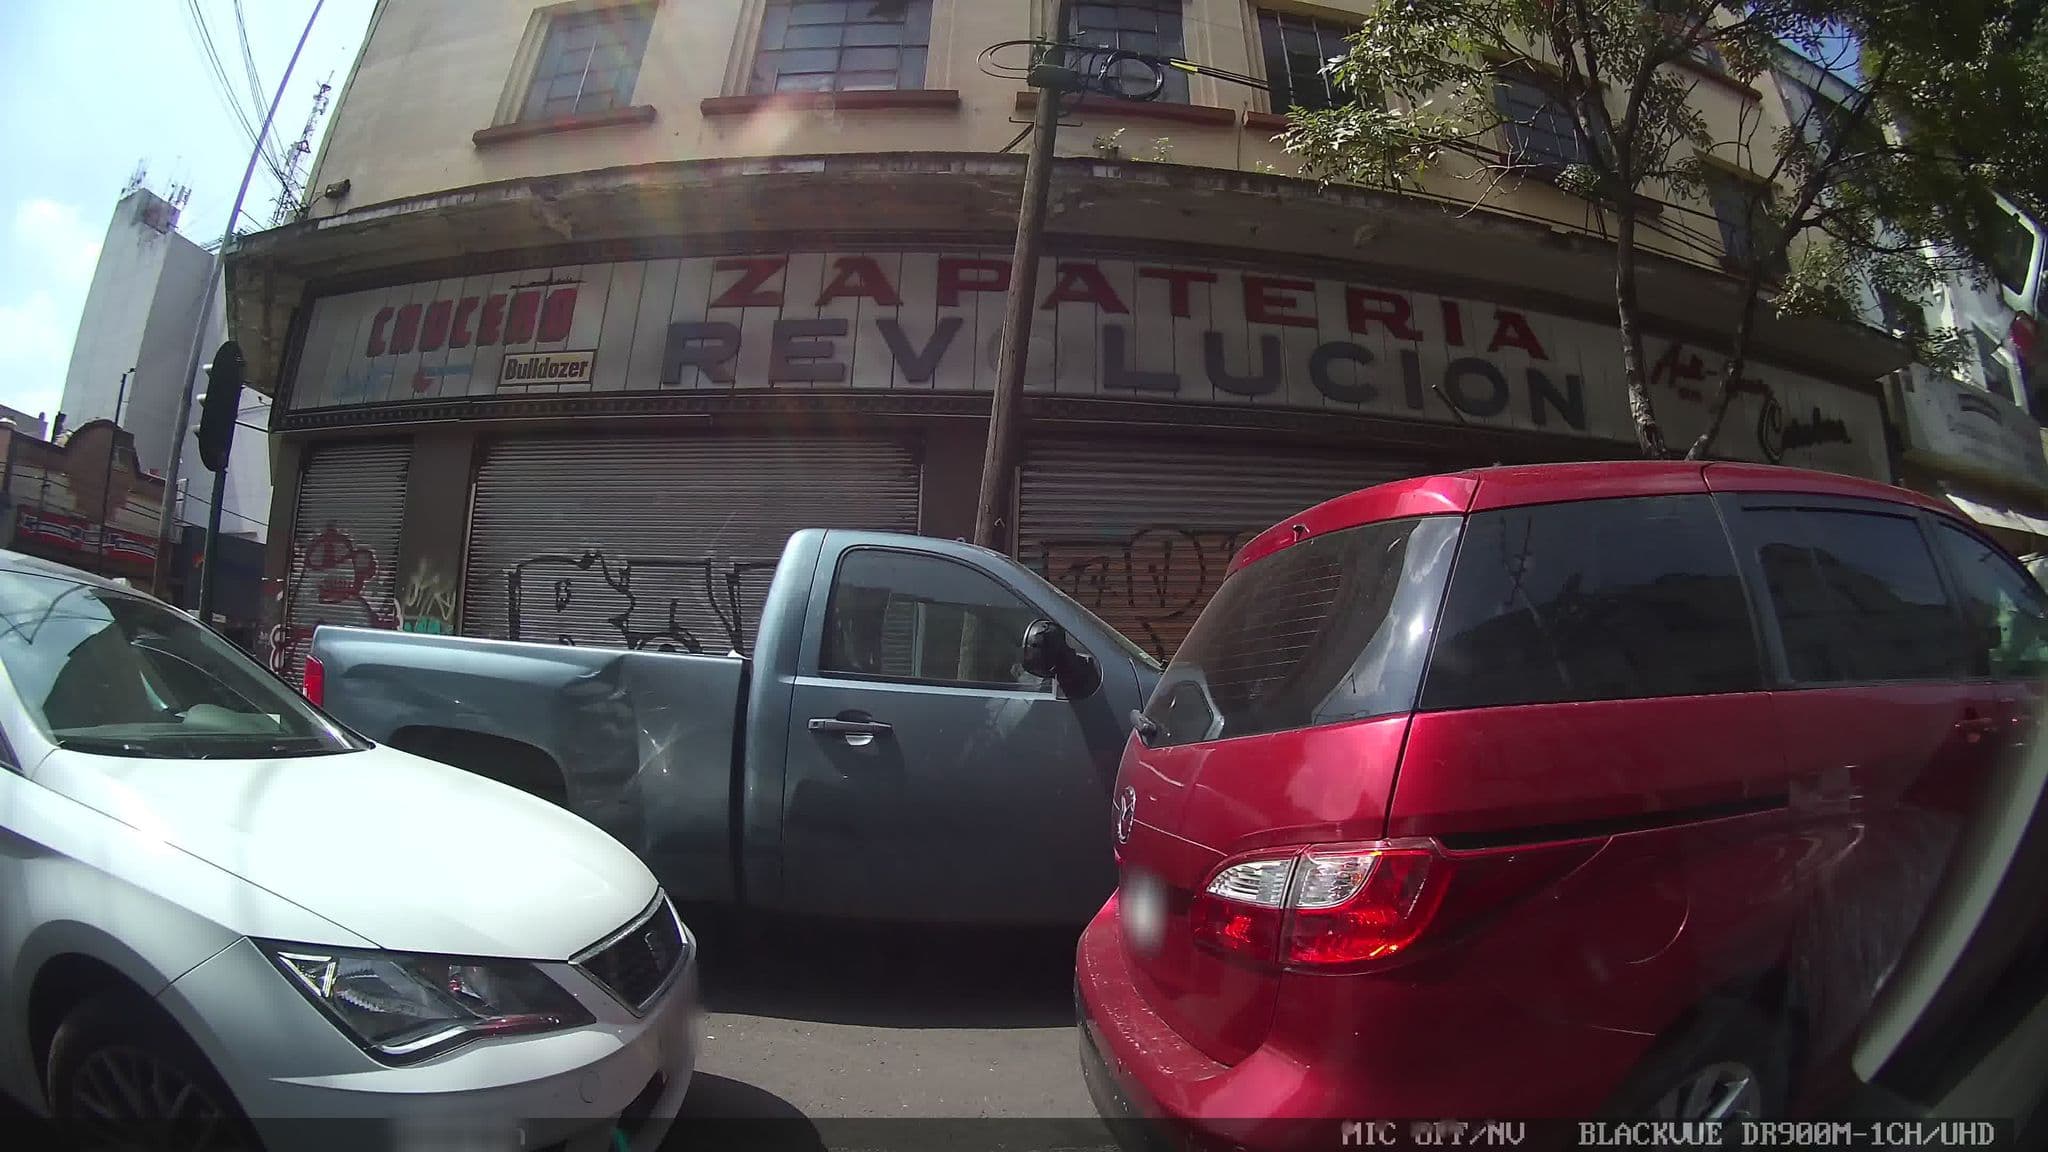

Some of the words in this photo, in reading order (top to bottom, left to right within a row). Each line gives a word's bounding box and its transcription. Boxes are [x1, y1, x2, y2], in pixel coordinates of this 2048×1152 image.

[709, 255, 1549, 361] ZAPATERIA
[504, 356, 590, 380] Bulldozer
[660, 316, 1586, 431] REVLUCION
